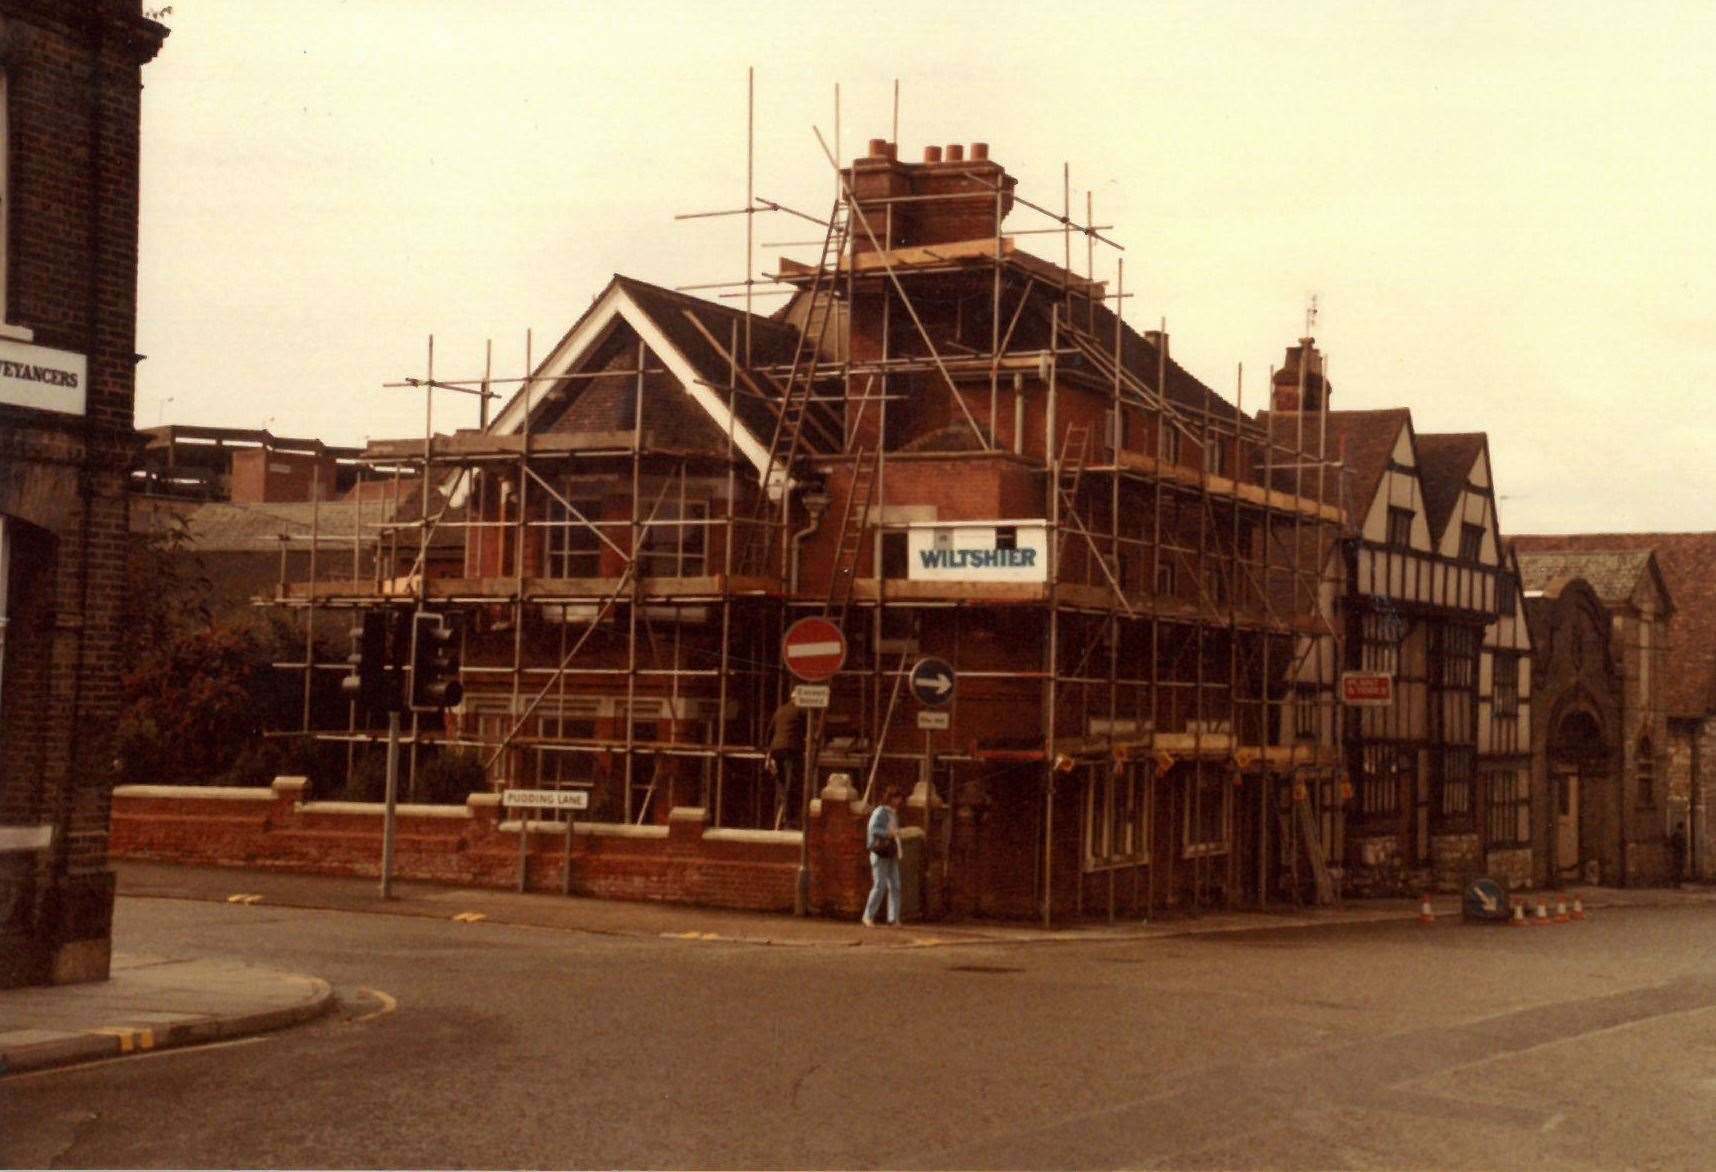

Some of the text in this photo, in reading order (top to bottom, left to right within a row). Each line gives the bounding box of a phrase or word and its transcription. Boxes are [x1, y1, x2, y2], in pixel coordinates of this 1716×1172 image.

[919, 548, 1037, 569] WILTSHIER
[507, 793, 584, 806] PUDDING LANE
